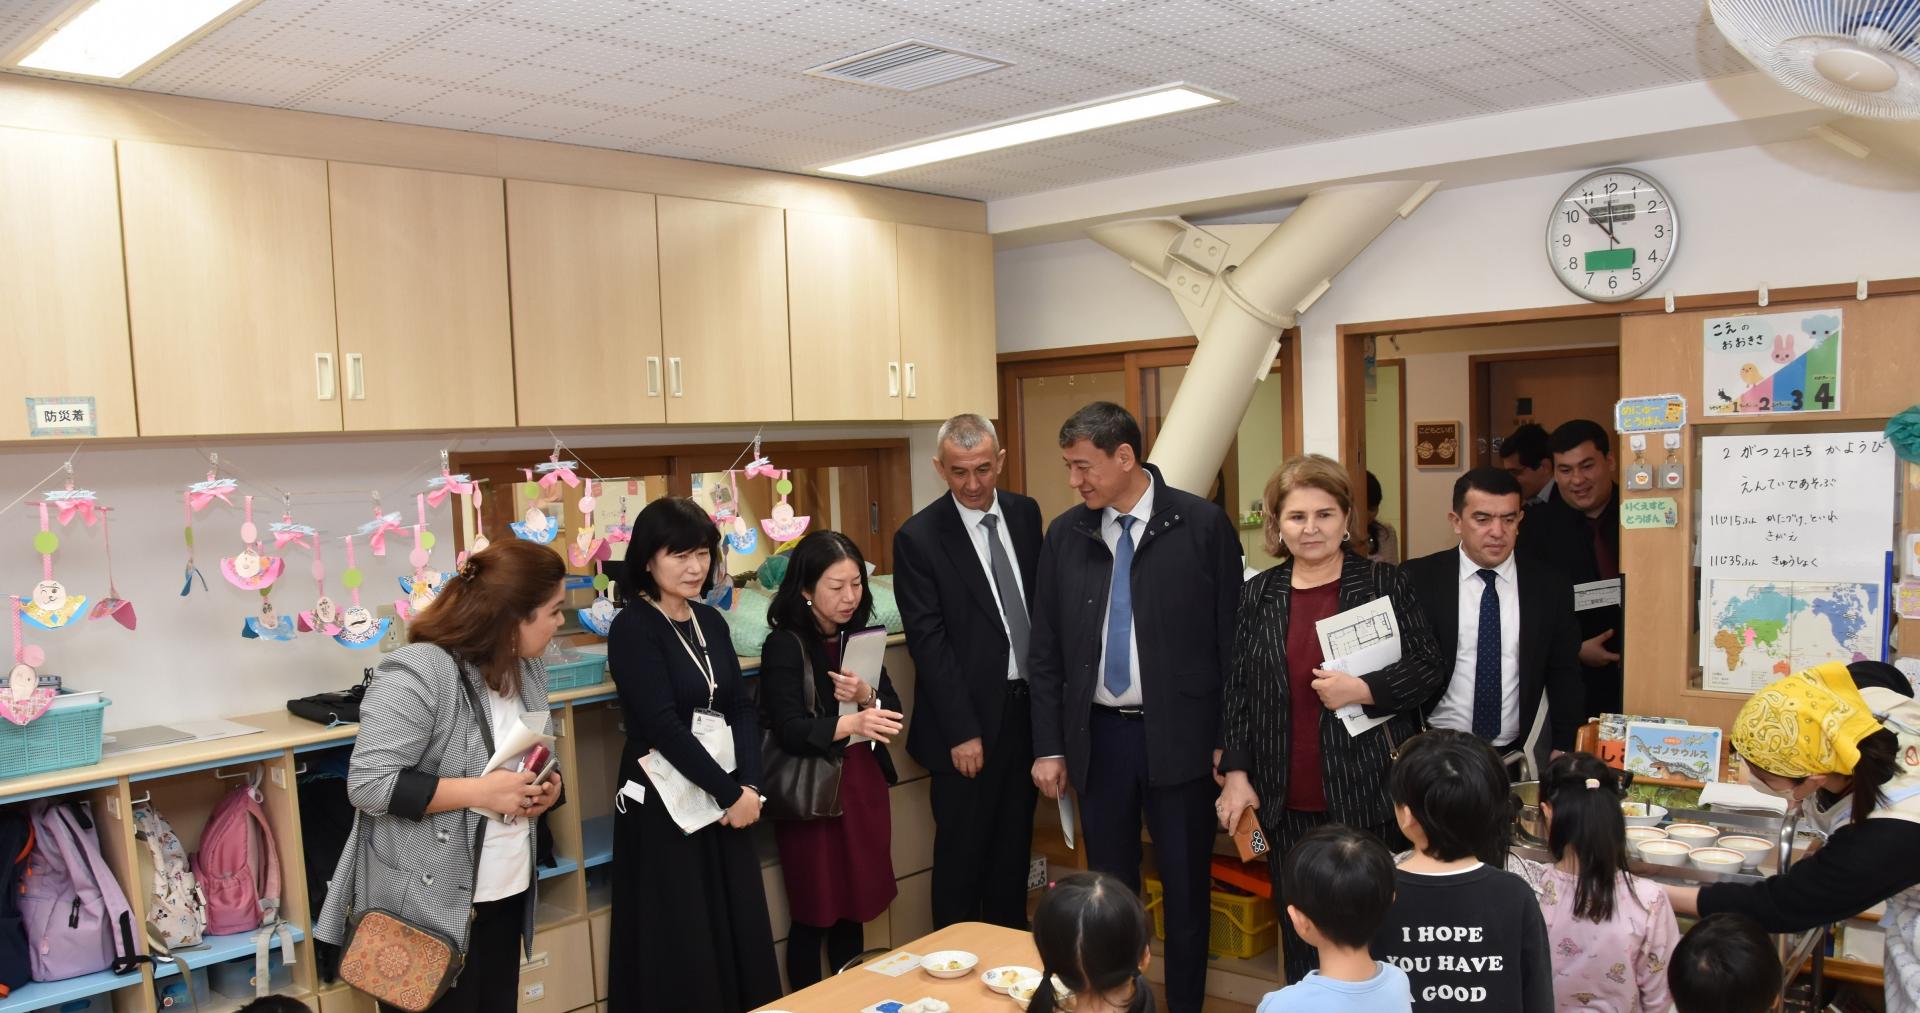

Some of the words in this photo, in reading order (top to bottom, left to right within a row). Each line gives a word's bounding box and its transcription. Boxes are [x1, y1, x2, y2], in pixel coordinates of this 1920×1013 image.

[1604, 182, 1618, 194] 12
[1632, 186, 1637, 200] 1
[1583, 191, 1594, 205] 11
[1648, 200, 1657, 214] 2
[1566, 210, 1580, 224] 10
[1654, 225, 1664, 239] 3
[1562, 234, 1571, 247] 9
[1647, 249, 1658, 263] 4
[1569, 257, 1578, 270] 8
[1585, 272, 1595, 285] 7
[1632, 268, 1641, 281] 5
[1608, 276, 1618, 289] 6
[1713, 322, 1750, 337] こえの
[1722, 334, 1764, 351] おおきさ
[1791, 389, 1804, 411] 3
[1814, 383, 1834, 410] 4
[1733, 402, 1740, 412] 1
[1759, 397, 1770, 411] 2
[44, 409, 85, 423] 防災着
[1723, 447, 1731, 460] 2
[1740, 444, 1769, 459] がつ
[1773, 445, 1812, 459] 24にち
[1825, 440, 1887, 456] かようび
[1741, 475, 1837, 495] えんていであそぶ
[1625, 501, 1666, 511] りくえすと
[1625, 514, 1661, 525] とうばん
[1765, 530, 1798, 541] きがえ
[1771, 555, 1819, 567] きゅうしょく
[1402, 927, 1411, 943] I
[1418, 926, 1483, 943] HOPE
[1437, 955, 1504, 973] HAVE
[1422, 984, 1487, 1002] GOOD
